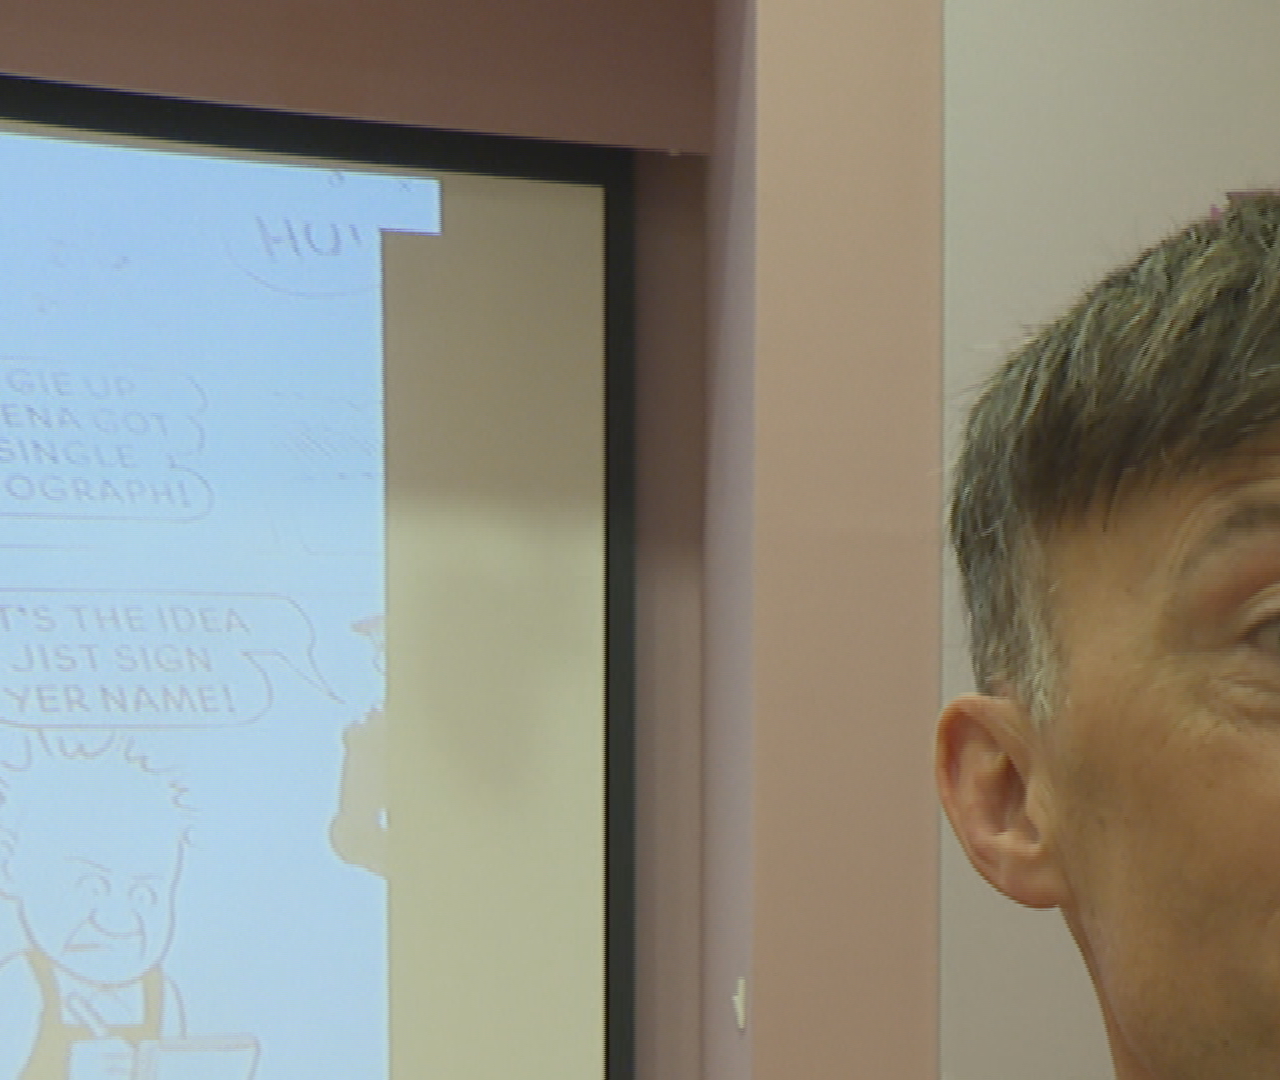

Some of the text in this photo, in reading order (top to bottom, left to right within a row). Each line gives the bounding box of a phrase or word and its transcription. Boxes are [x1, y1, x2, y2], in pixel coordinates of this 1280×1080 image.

[94, 408, 169, 437] GOT
[65, 603, 145, 632] THE
[158, 604, 252, 635] IDEA
[12, 643, 213, 673] JIST SIGN
[2, 683, 238, 713] YER NAME!
